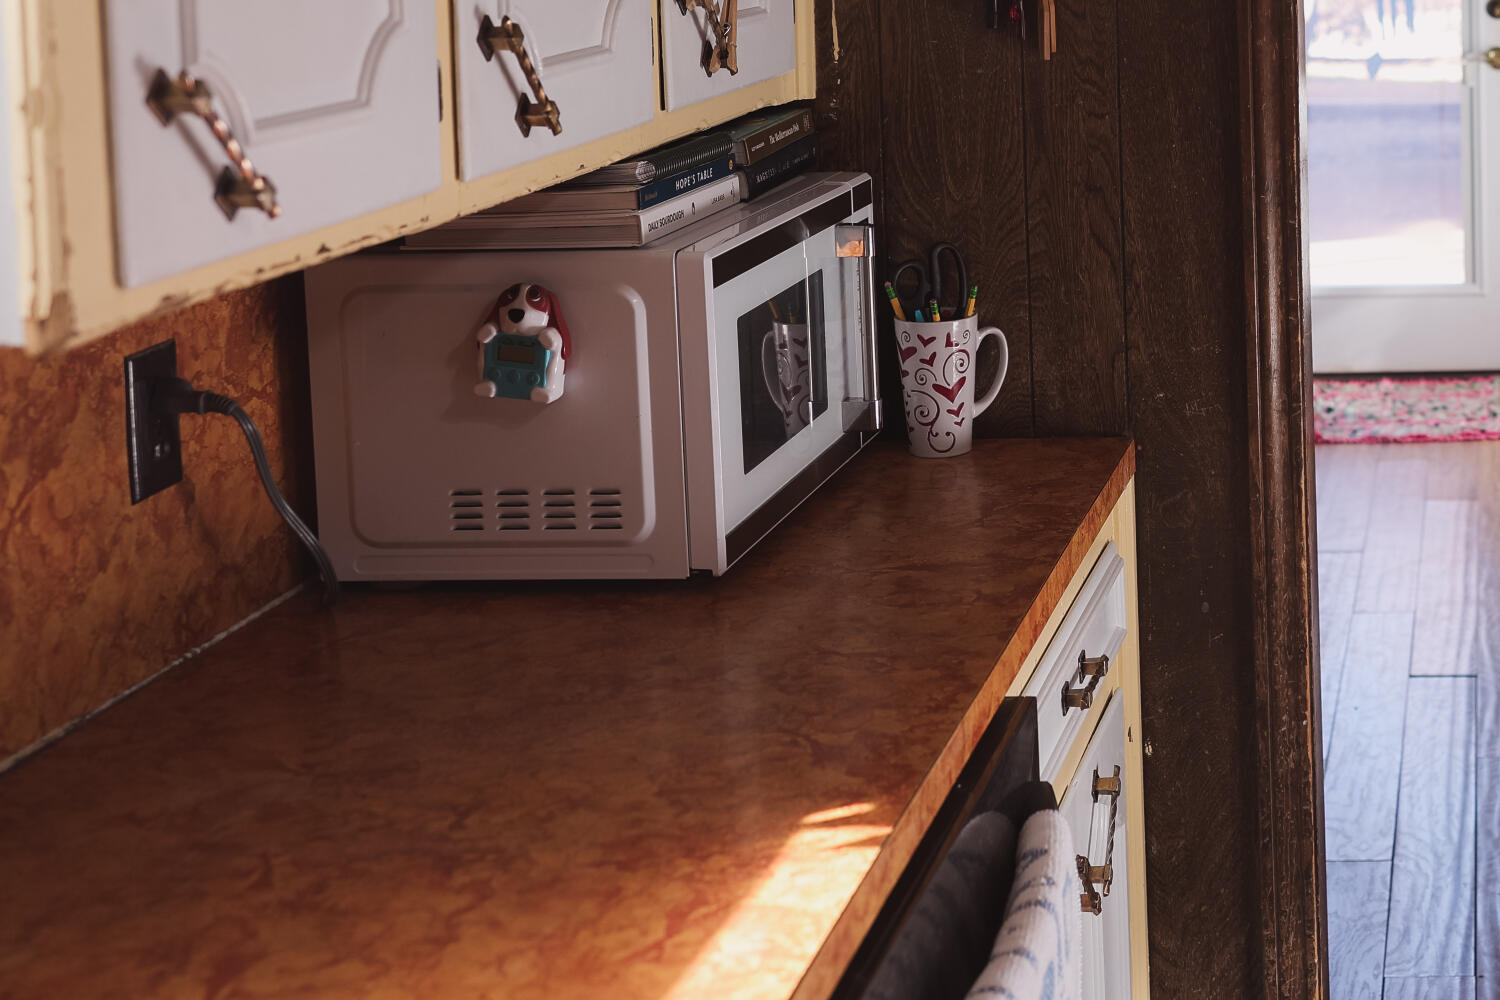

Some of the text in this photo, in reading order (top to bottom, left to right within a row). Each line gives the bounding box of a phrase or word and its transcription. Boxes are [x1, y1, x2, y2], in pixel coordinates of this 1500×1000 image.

[675, 167, 713, 191] HOPE'S TABLE
[647, 209, 685, 232] DAILY SOURDOUGH
